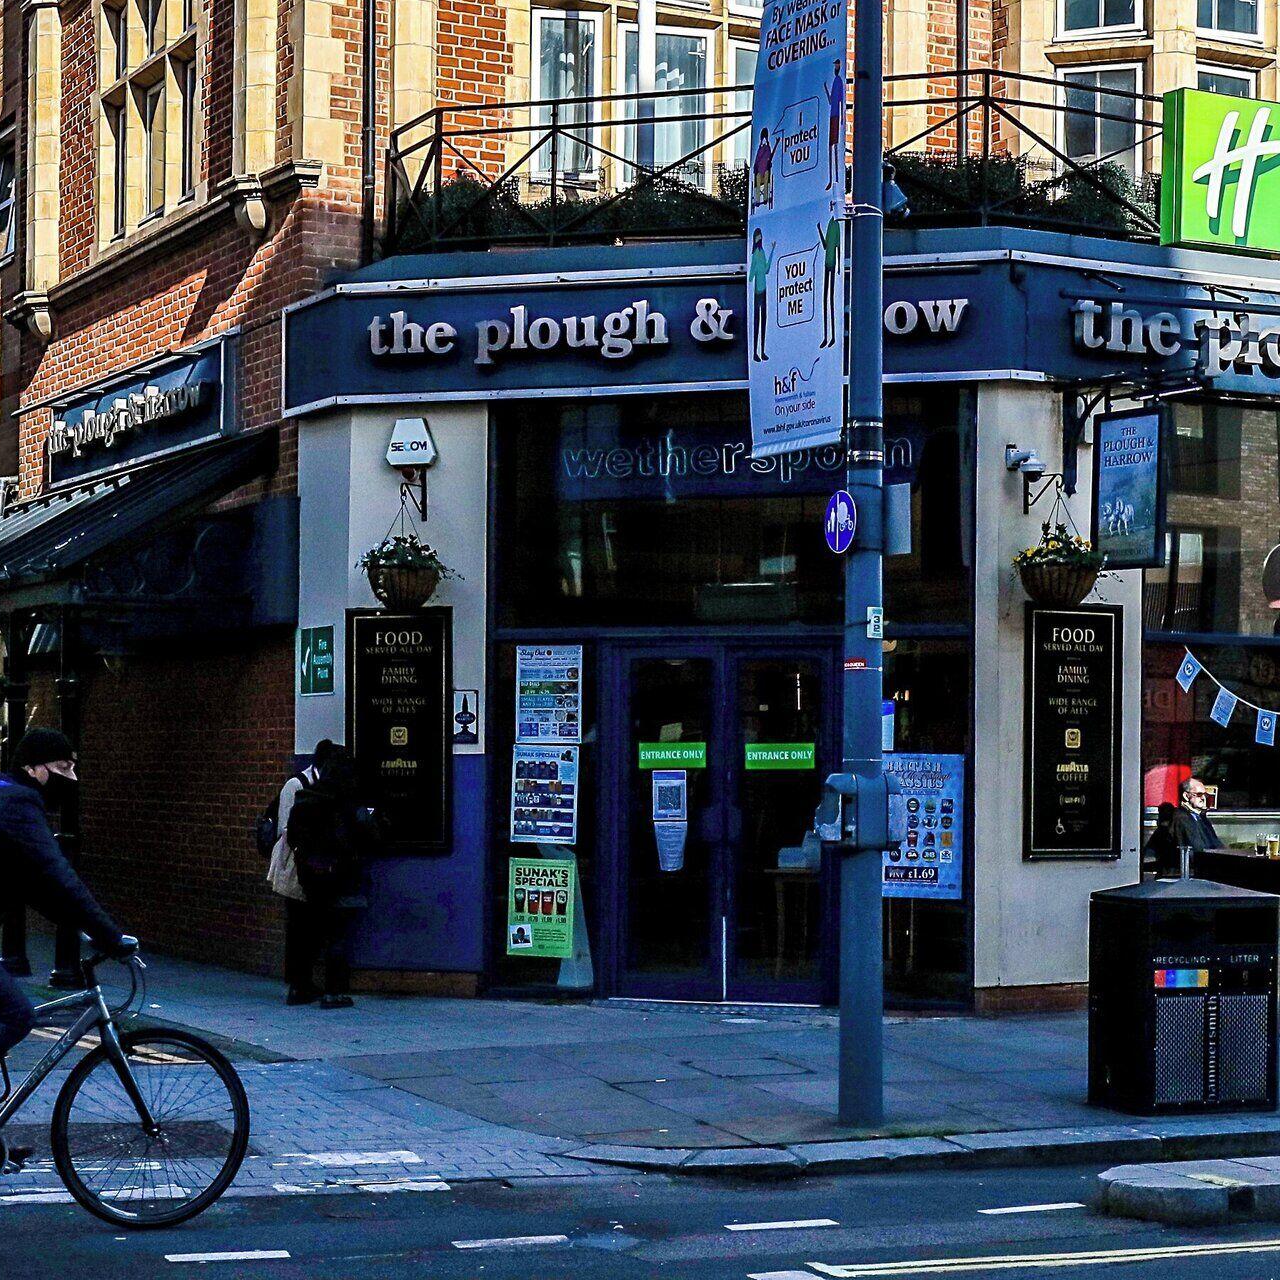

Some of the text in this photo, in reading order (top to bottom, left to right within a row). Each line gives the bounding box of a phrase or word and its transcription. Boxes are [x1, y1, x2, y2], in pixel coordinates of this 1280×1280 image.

[771, 5, 784, 24] By
[765, 1, 842, 51] FACE MASK or
[767, 30, 837, 71] COVERING...
[798, 111, 803, 127] I
[784, 124, 818, 152] protect
[790, 146, 810, 166] YOU
[784, 261, 806, 280] YOU
[779, 277, 813, 303] protect
[787, 300, 804, 317] ME
[368, 297, 734, 365] the plough &
[1074, 296, 1181, 358] the
[774, 370, 797, 396] h&f
[774, 399, 816, 418] On your side
[1121, 426, 1137, 437] THE
[391, 440, 428, 452] SECOM
[1103, 436, 1155, 453] PLOUGH &
[561, 432, 914, 483] wetherspon
[1103, 451, 1154, 468] HARROW
[375, 631, 424, 646] FOOD
[1052, 627, 1096, 643] FOOD
[365, 646, 433, 655] SERVED ALL DAY
[1043, 642, 1104, 653] SERVED ALL DAY
[382, 666, 416, 676] FAMILY
[1058, 665, 1089, 675] FAMILY
[381, 675, 418, 685] DINING
[1057, 674, 1090, 685] DINING
[371, 696, 428, 706] WIDE RANGE
[1048, 697, 1099, 707] WIDE RANGE
[382, 705, 417, 714] OF ALES
[1057, 706, 1089, 715] OF ALES
[640, 750, 704, 760] ENTRANCE ONLY
[746, 750, 813, 761] ENTRANCE ONLY
[380, 757, 418, 769] LAVAZZA
[1056, 760, 1089, 773] LAVAZZA
[1056, 772, 1089, 782] COFFEE
[515, 867, 569, 879] SUNAK'S
[907, 867, 935, 879] £1.69
[514, 877, 569, 888] SPECIALS
[1156, 954, 1260, 964] RECYCLING LITTER
[1206, 994, 1218, 1102] hammersmith
